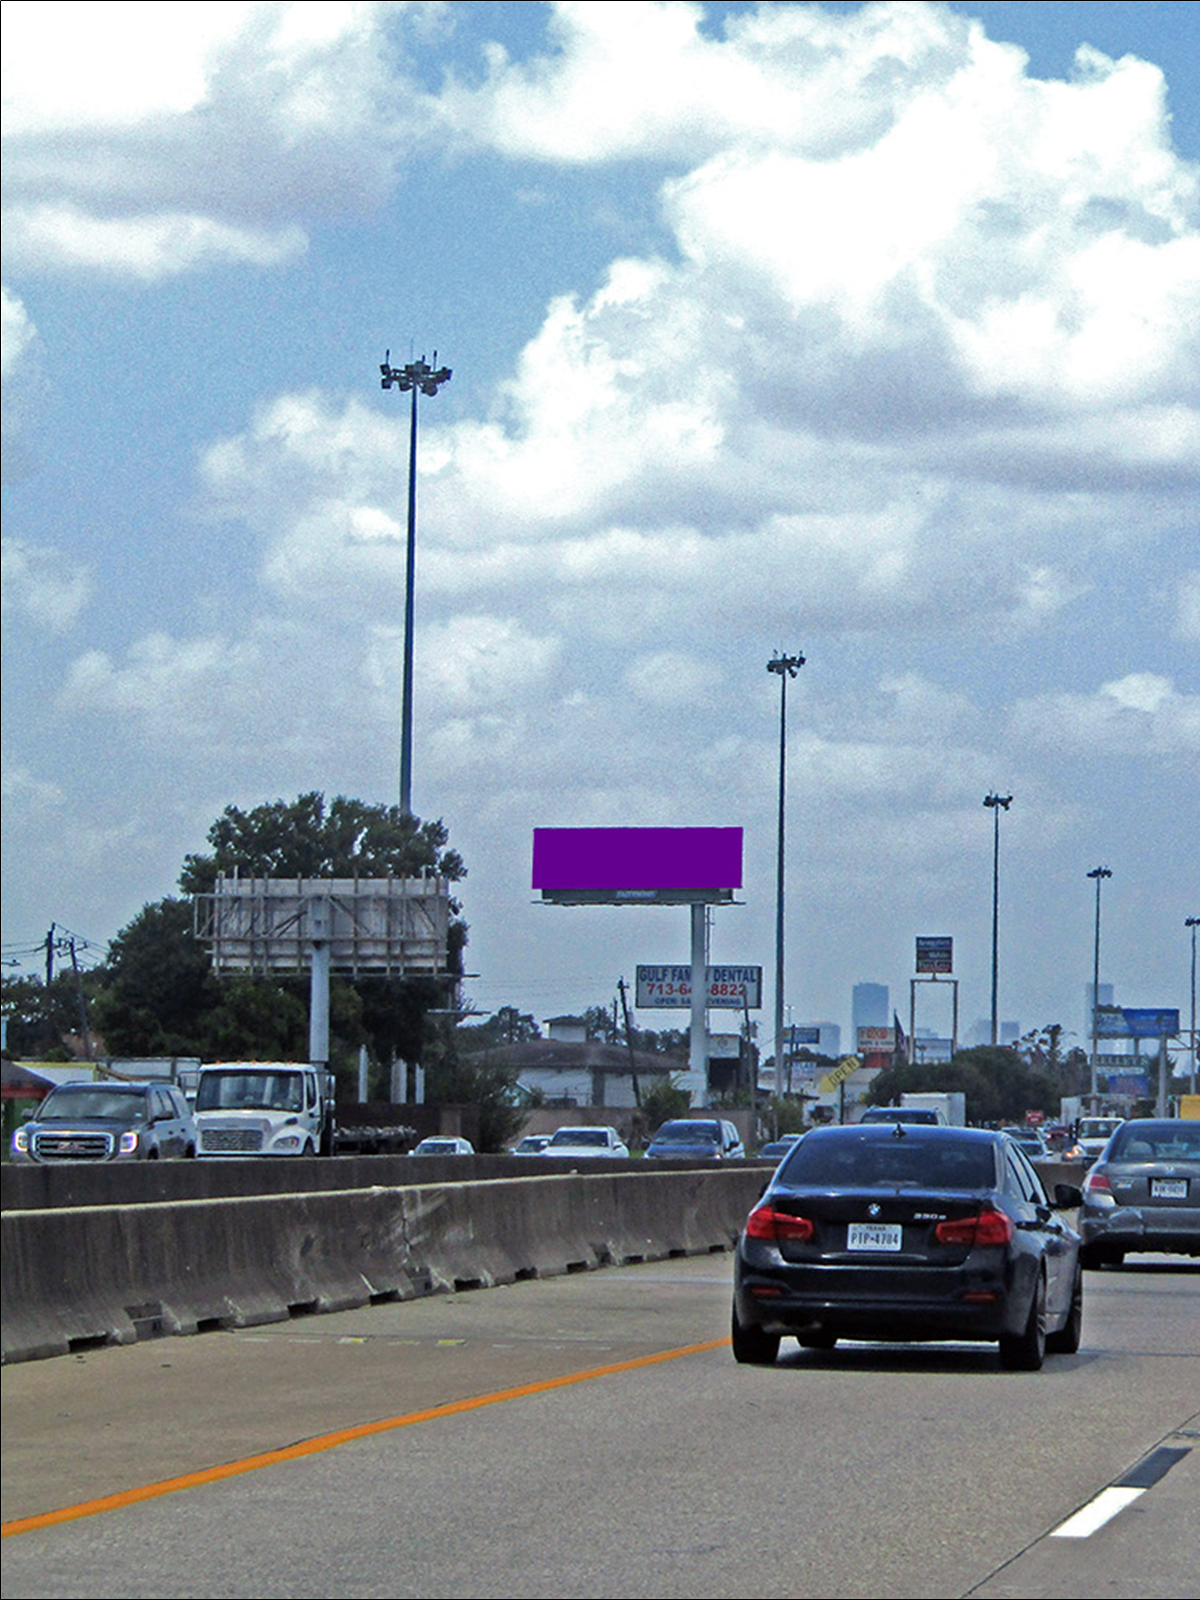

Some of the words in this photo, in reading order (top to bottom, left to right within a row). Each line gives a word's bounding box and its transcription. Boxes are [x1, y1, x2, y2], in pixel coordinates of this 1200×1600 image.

[640, 969, 669, 982] GULF
[714, 970, 756, 983] DENTAL
[828, 1059, 857, 1086] OPEN
